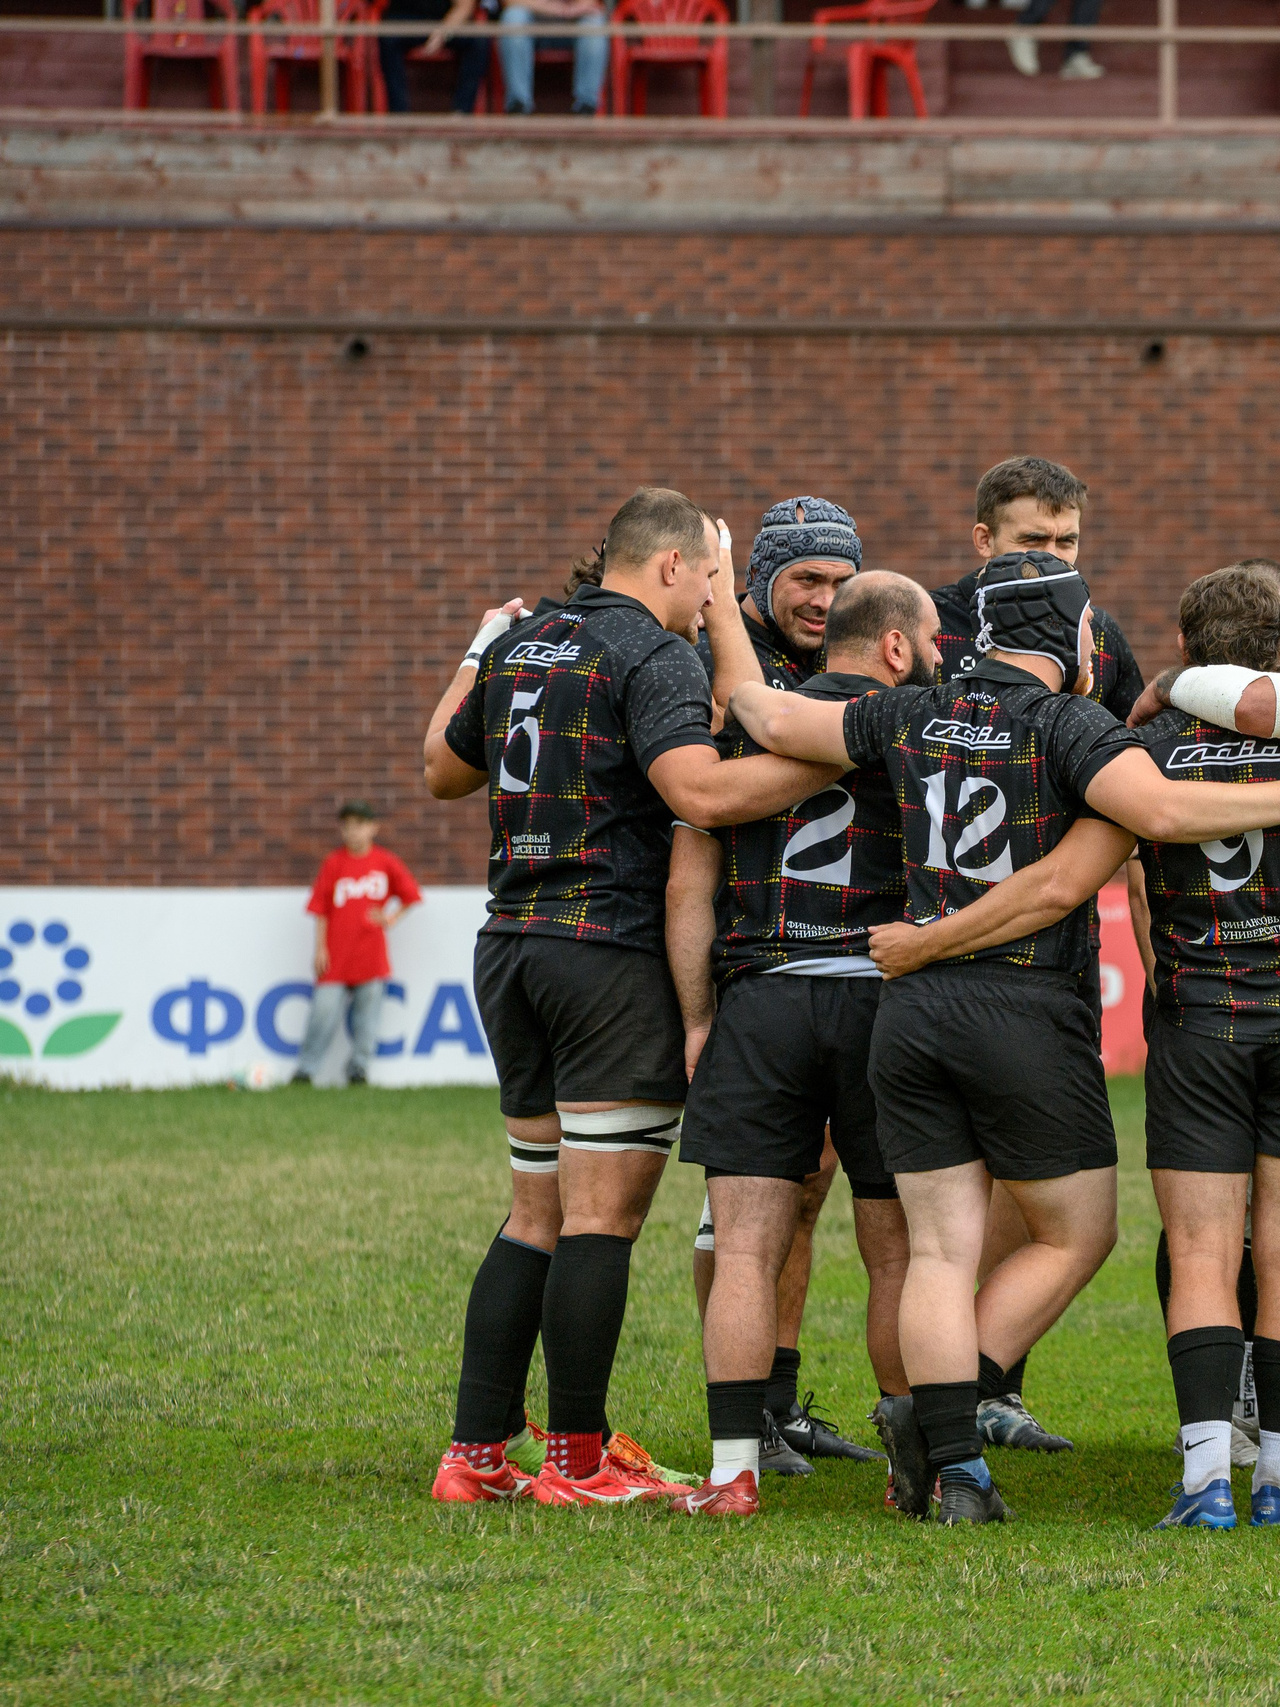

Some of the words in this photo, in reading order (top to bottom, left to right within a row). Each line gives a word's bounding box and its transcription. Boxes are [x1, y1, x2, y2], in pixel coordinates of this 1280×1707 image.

[500, 686, 544, 793] 5
[781, 783, 856, 887] 2
[920, 770, 1014, 883] 12
[1200, 829, 1263, 892] 9
